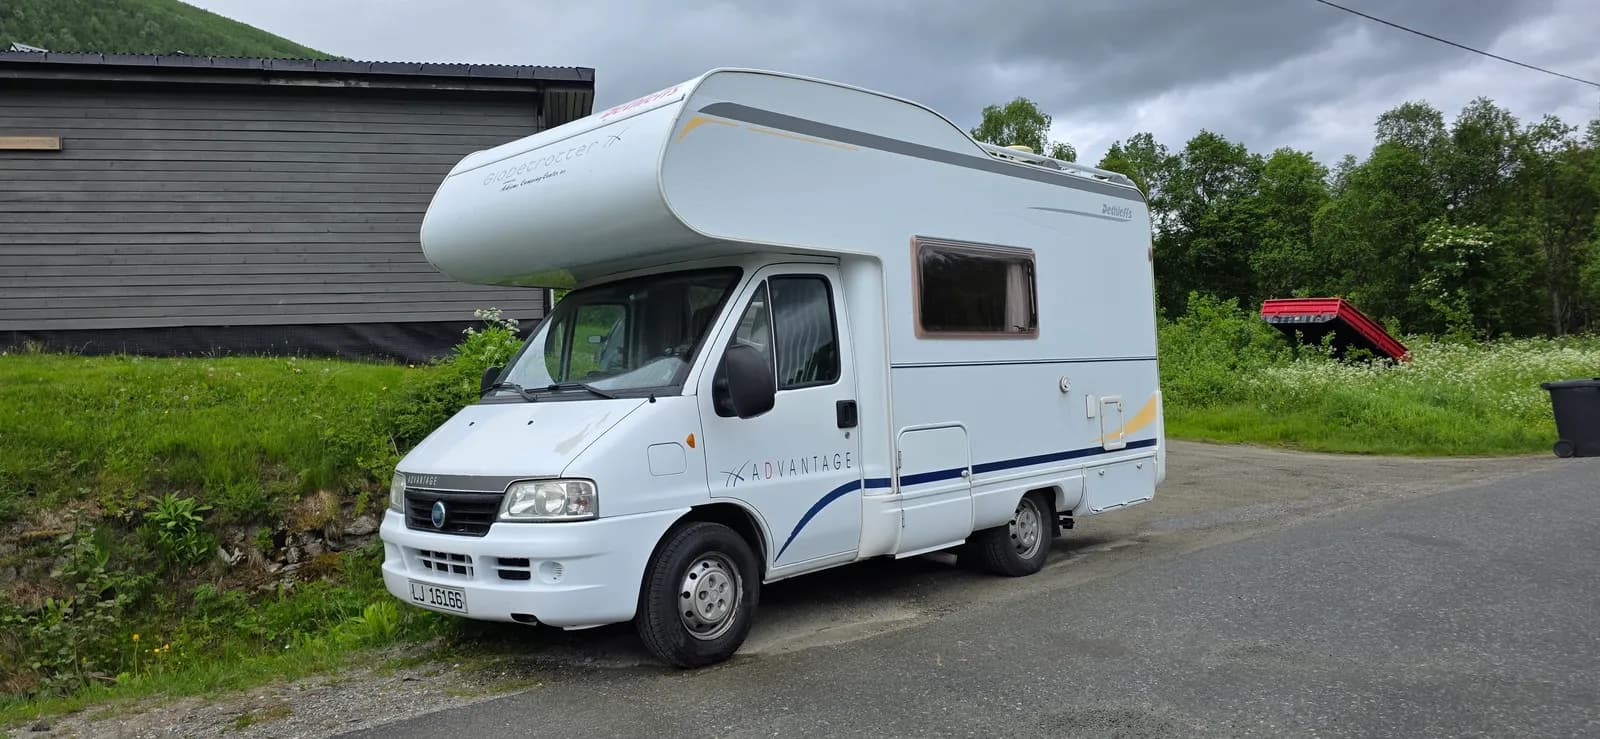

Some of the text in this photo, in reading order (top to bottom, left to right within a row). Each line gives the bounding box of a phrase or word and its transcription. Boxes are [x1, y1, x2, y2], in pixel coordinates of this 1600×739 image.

[752, 452, 851, 480] ADVANTAGE
[408, 475, 437, 486] ADVANTAGE
[411, 583, 463, 609] LJ 16166
